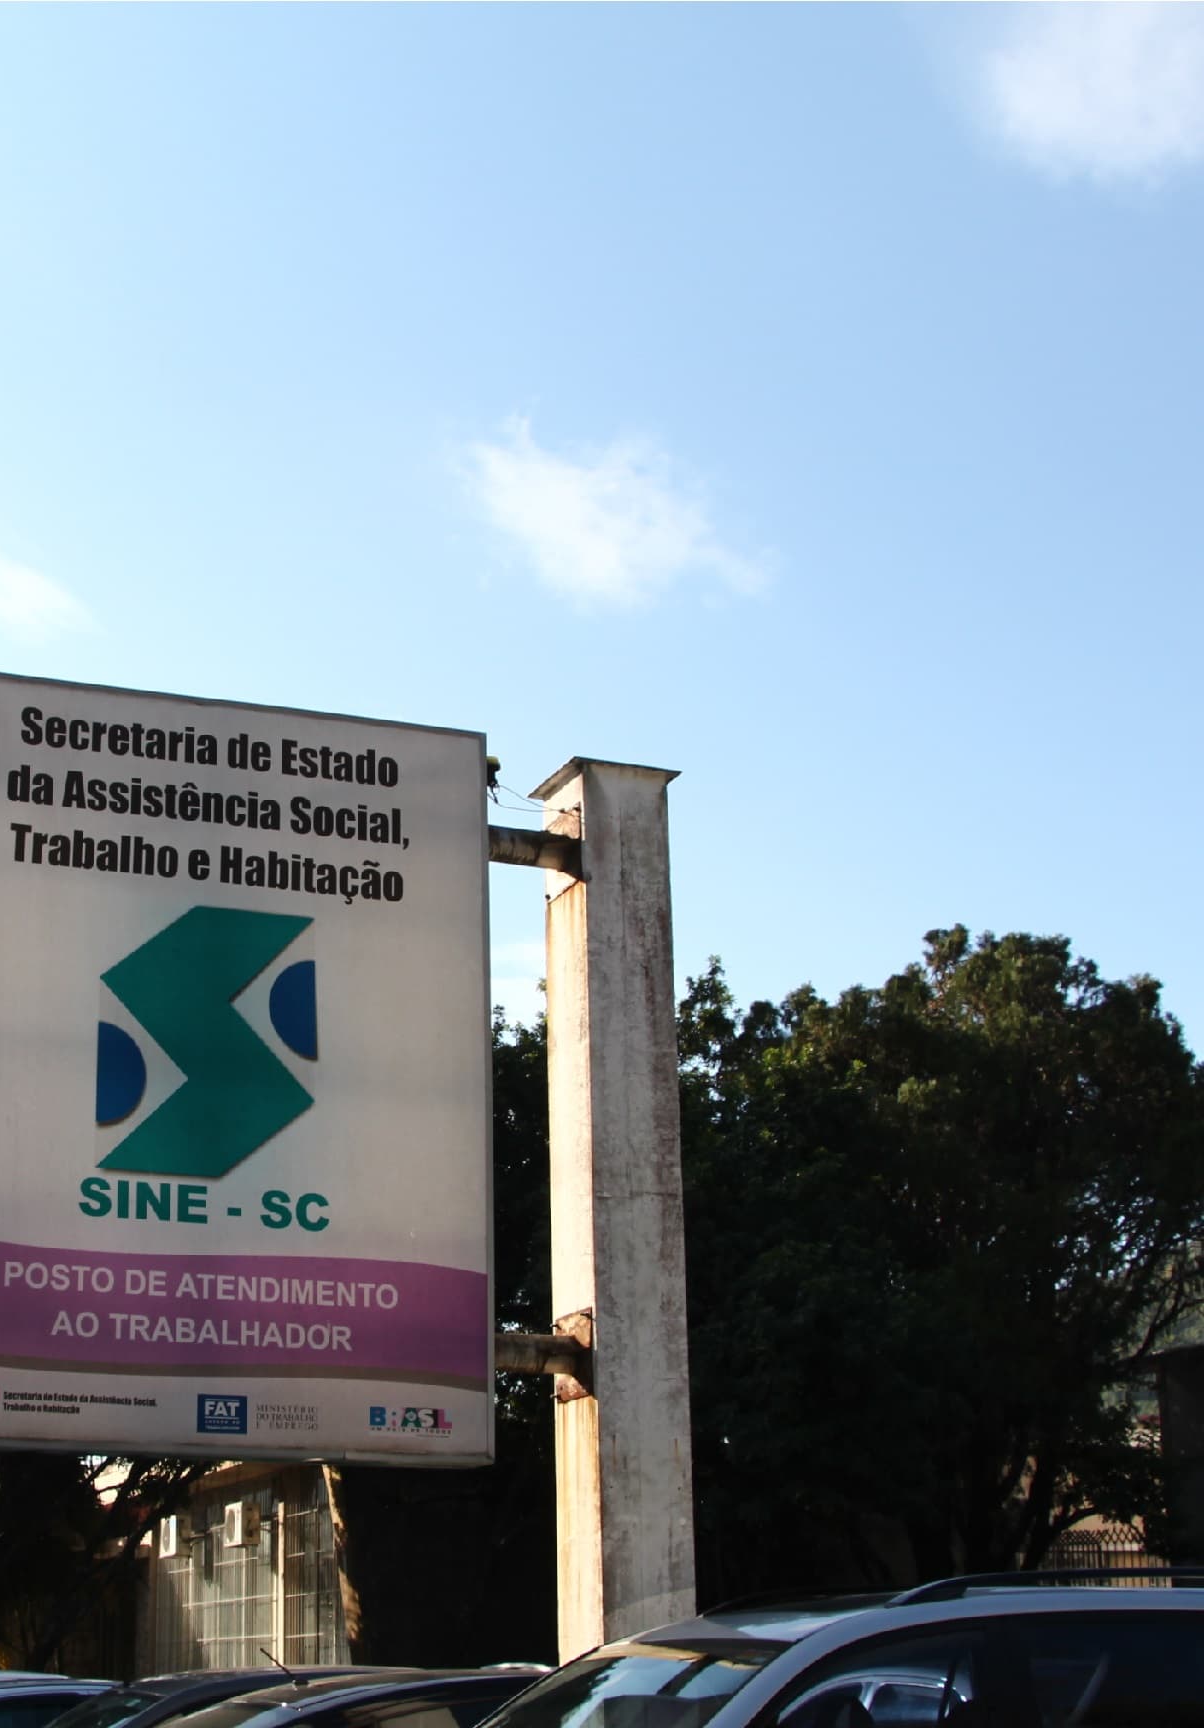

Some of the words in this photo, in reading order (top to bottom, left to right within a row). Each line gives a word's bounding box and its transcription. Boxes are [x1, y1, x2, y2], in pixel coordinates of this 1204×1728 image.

[20, 706, 217, 766] Secretaria
[227, 733, 271, 772] de
[281, 740, 399, 788] Estado
[7, 765, 54, 806] da
[62, 770, 280, 831] Assistência
[290, 797, 410, 850] Social,
[10, 823, 178, 879] Trabalho
[187, 849, 210, 881] e
[219, 845, 404, 905] Habitação
[78, 1177, 208, 1224] SINE
[260, 1189, 330, 1232] SC
[3, 1261, 115, 1292] POSTO
[124, 1269, 167, 1297] DE
[175, 1273, 399, 1309] ATENDIMENTO
[51, 1310, 99, 1337] AO
[109, 1313, 353, 1352] TRABALHADOR
[3, 1391, 42, 1401] Secretaria
[3, 1402, 36, 1412] Trabalho
[204, 1400, 240, 1417] FAT
[256, 1412, 269, 1421] DO
